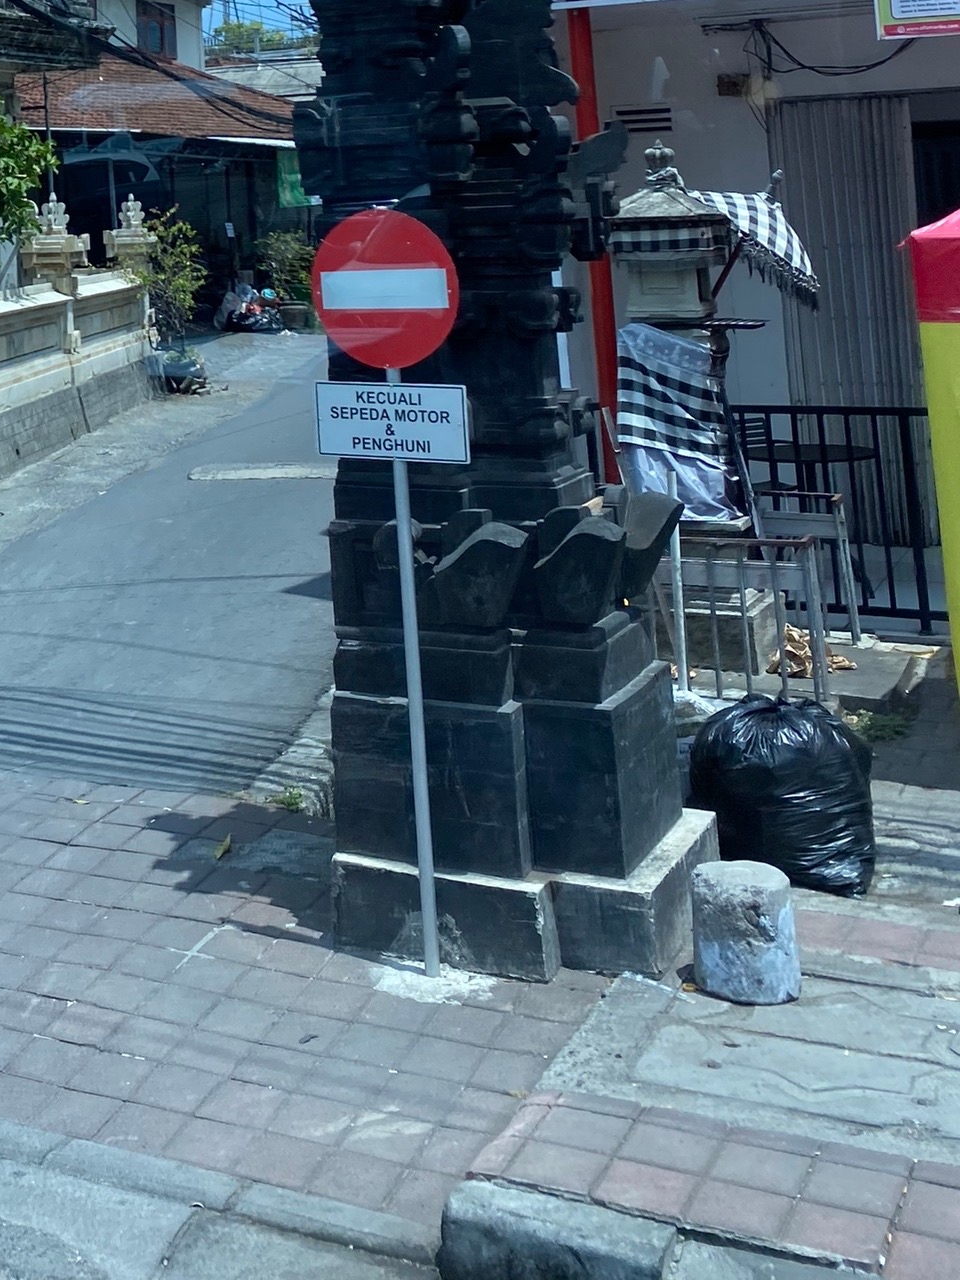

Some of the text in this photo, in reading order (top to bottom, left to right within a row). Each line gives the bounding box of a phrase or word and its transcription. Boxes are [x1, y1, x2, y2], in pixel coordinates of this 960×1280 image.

[355, 391, 421, 406] KECUALI
[330, 406, 451, 424] SEPEDA MOTOR
[385, 423, 395, 436] &
[352, 436, 431, 453] PENGHUNI
